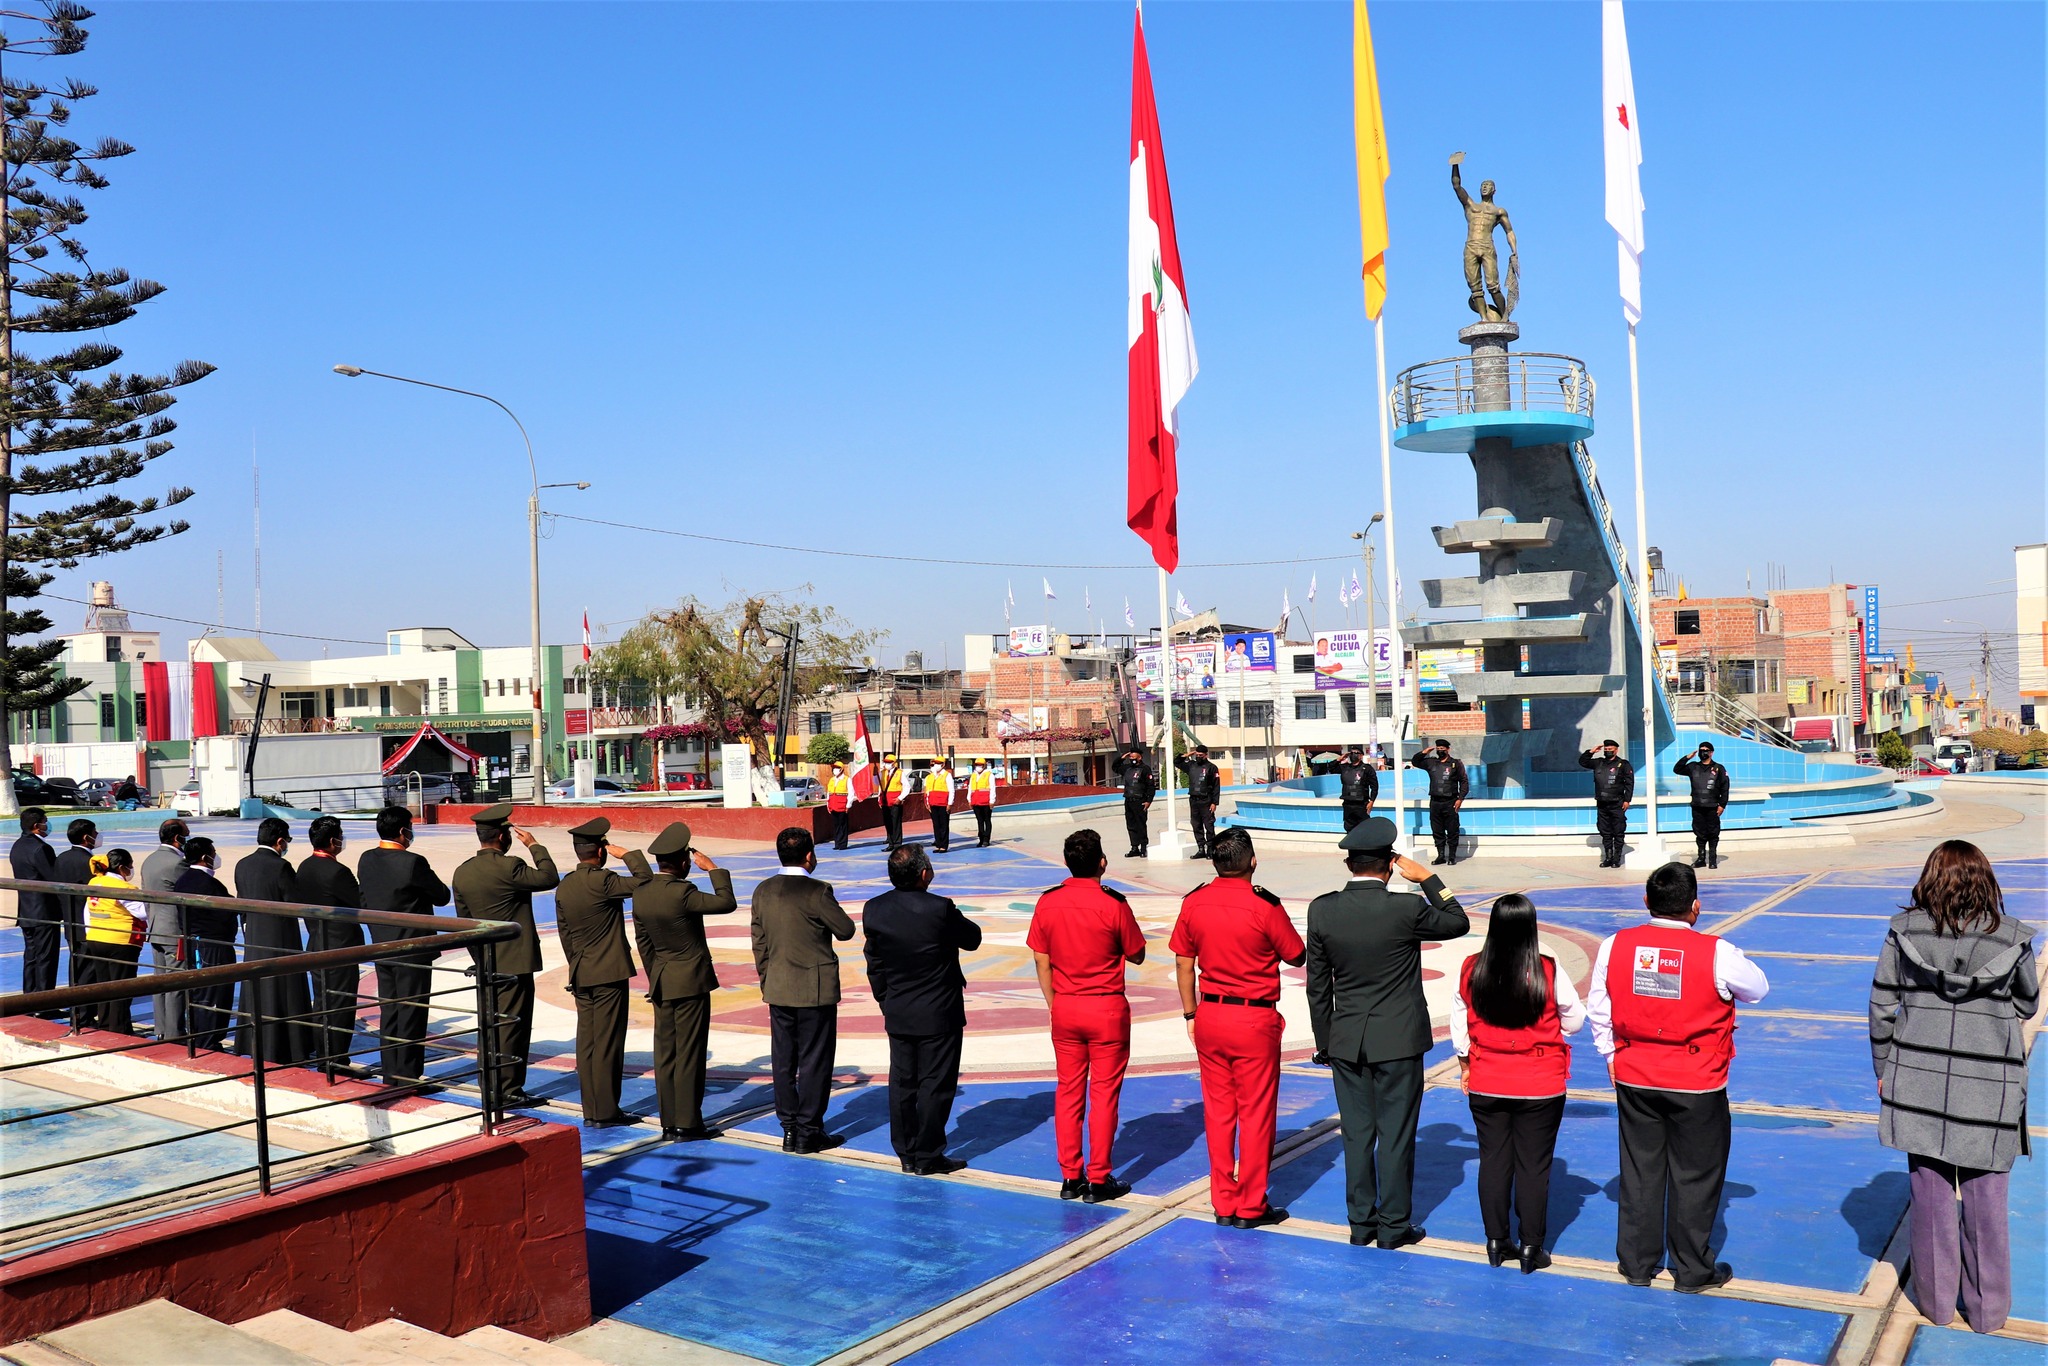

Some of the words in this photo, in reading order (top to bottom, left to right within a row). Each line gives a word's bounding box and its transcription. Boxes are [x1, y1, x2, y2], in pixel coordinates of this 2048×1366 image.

[1867, 590, 1876, 653] HOSPEDAJE
[1032, 633, 1042, 643] FE
[1333, 633, 1357, 641] JULIO
[1330, 642, 1360, 651] CUEVA
[434, 718, 469, 728] DISTRITO
[470, 719, 480, 727] DE
[481, 718, 508, 727] CIUDAD
[509, 718, 532, 726] NUEVA
[1660, 958, 1679, 967] PERÚ
